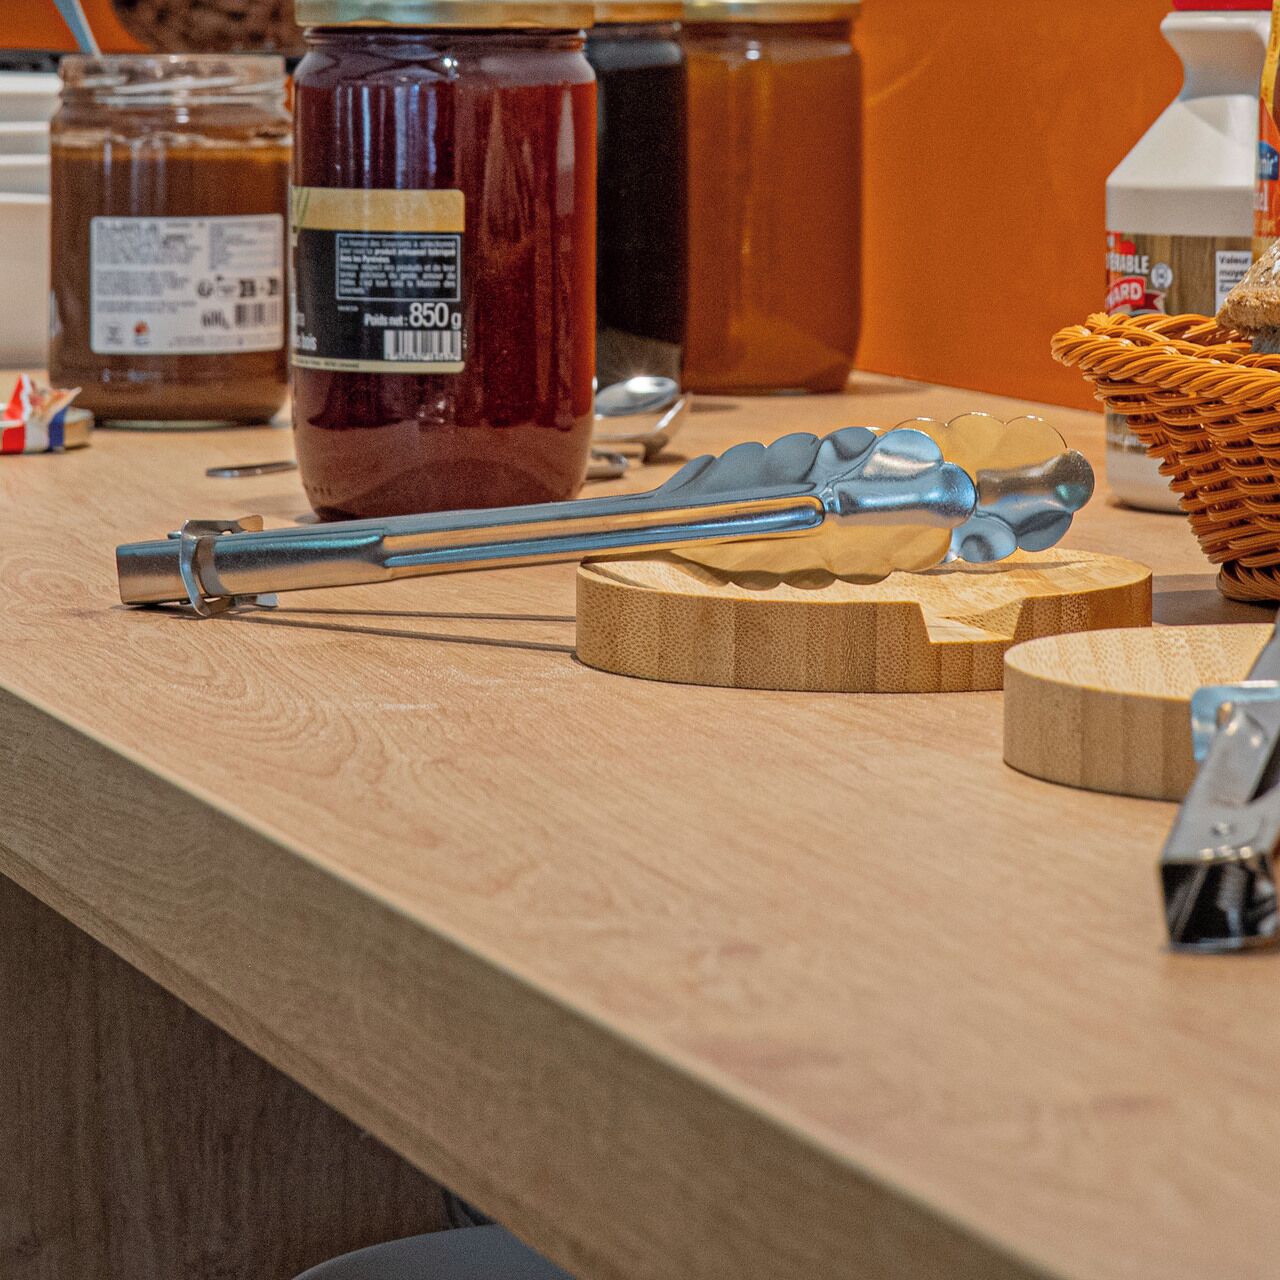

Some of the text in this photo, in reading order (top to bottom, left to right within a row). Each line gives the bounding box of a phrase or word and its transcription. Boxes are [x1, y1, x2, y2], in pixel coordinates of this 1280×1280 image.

[1219, 256, 1249, 265] Valeur
[364, 313, 388, 327] Poids
[409, 302, 450, 328] 850
[451, 312, 462, 329] g
